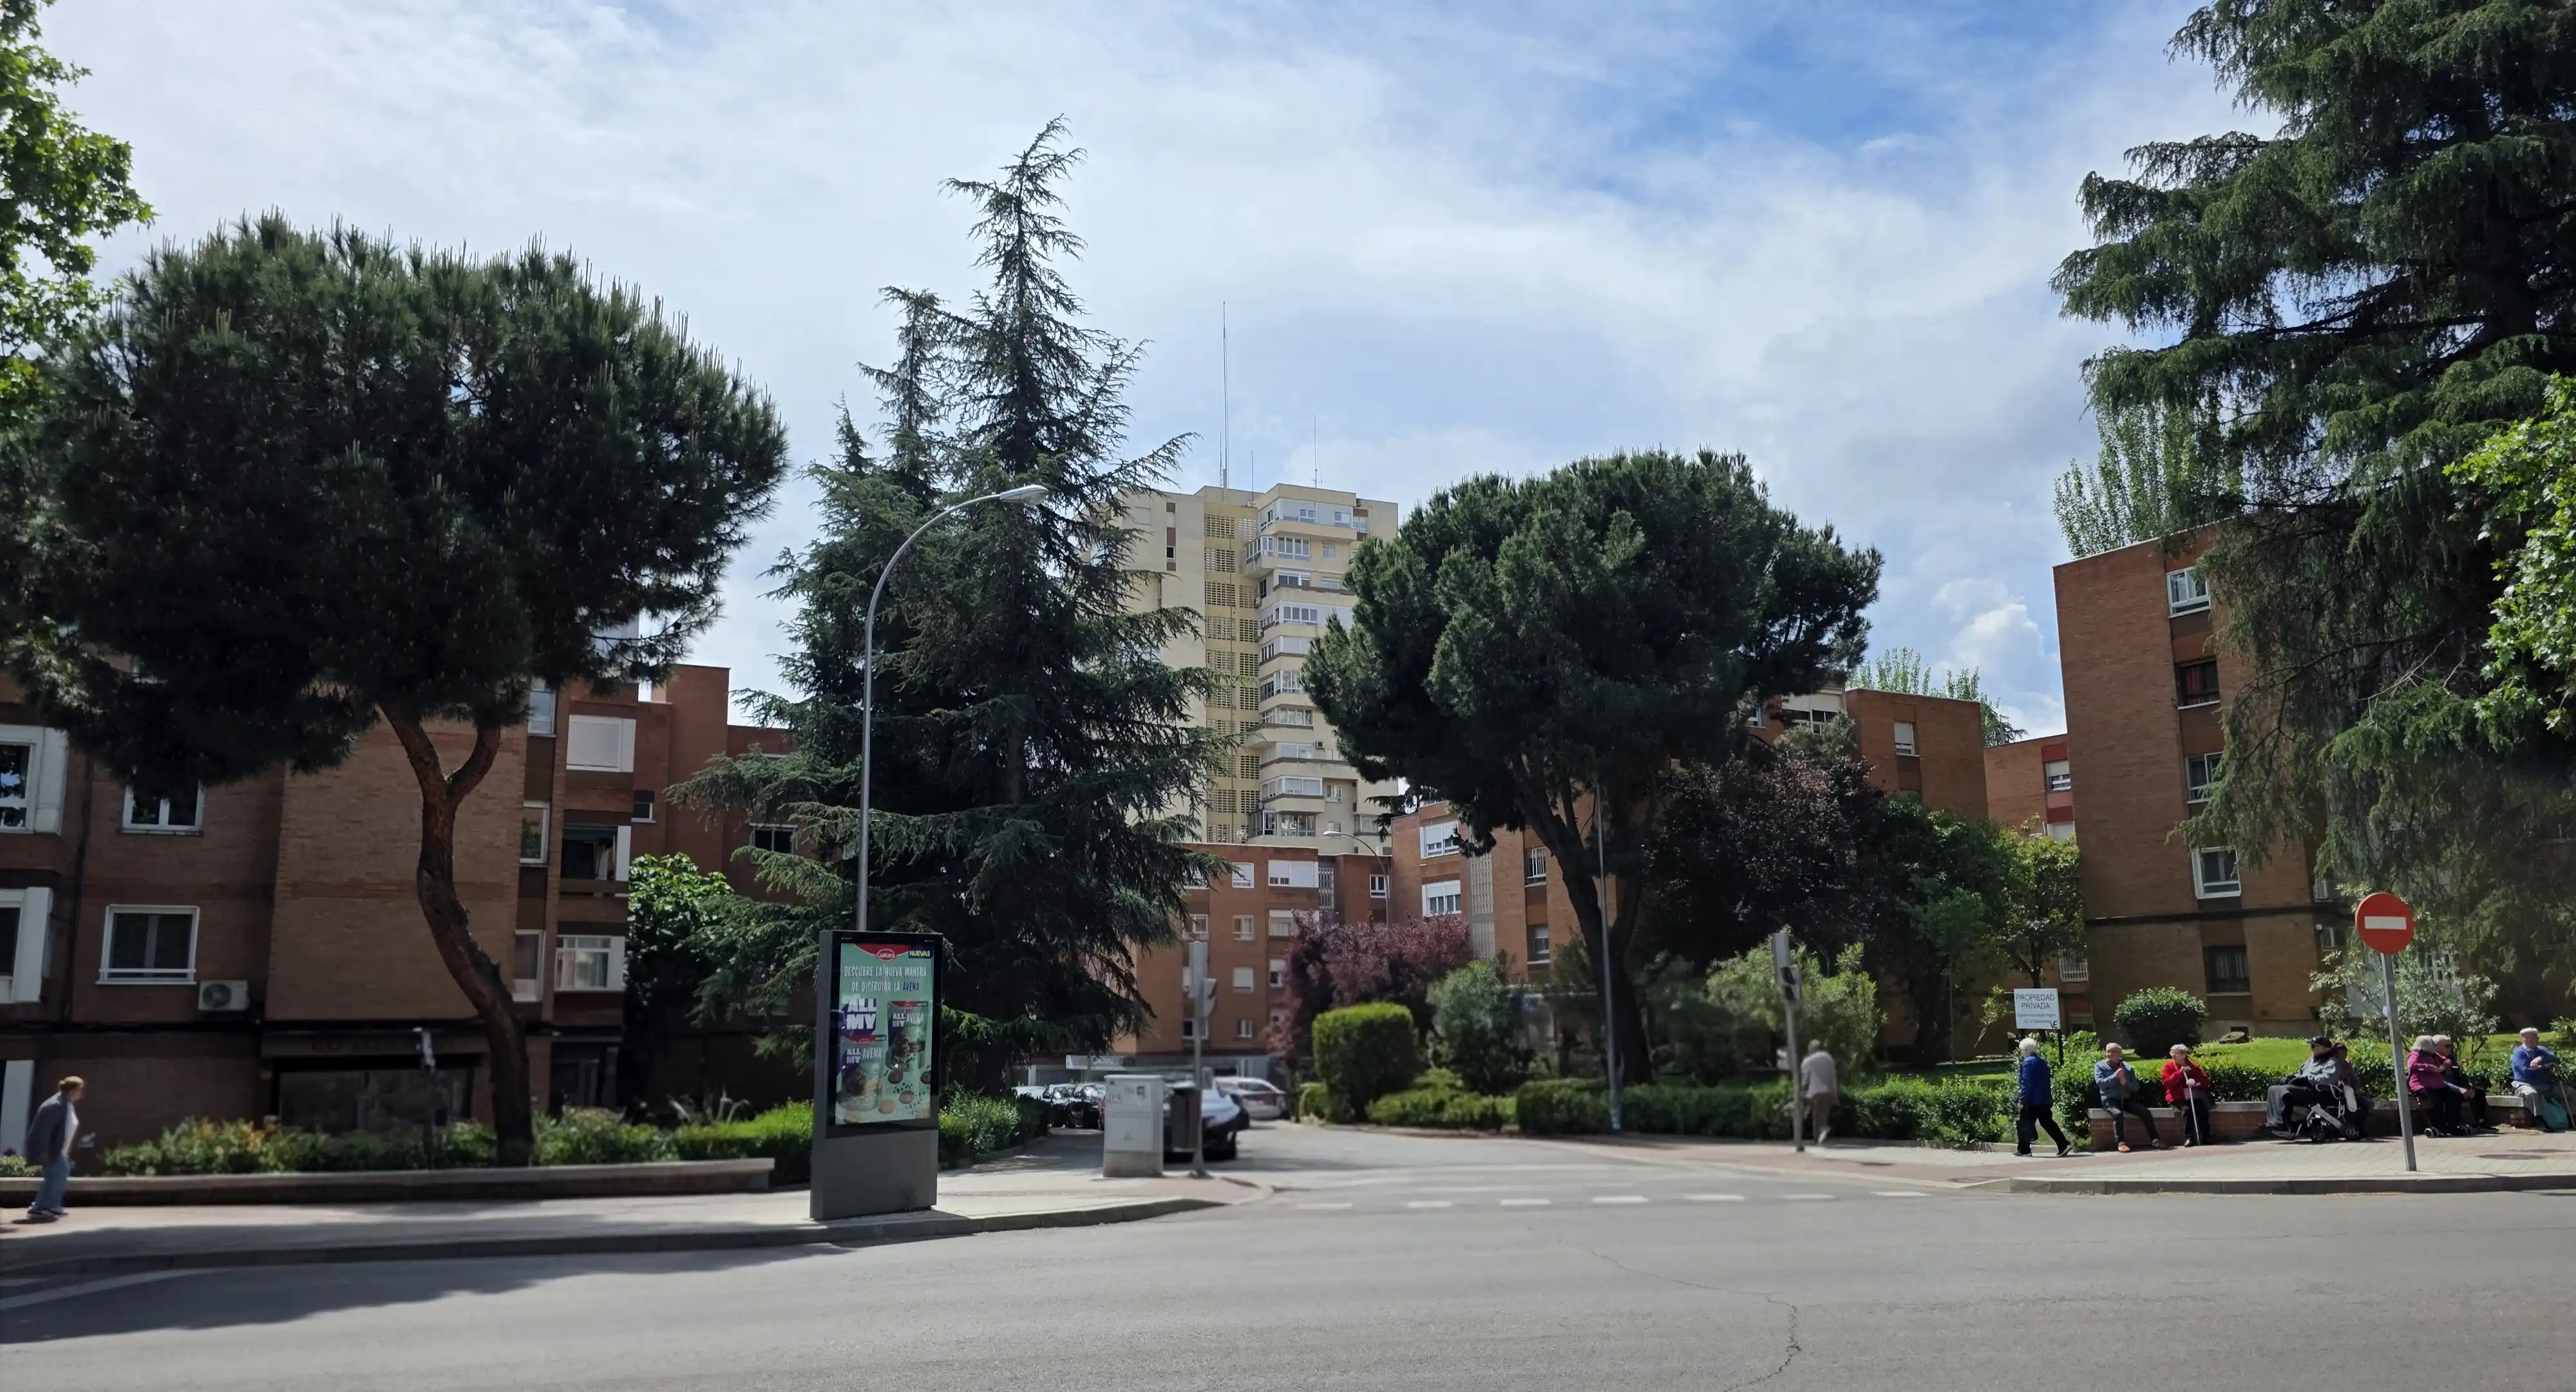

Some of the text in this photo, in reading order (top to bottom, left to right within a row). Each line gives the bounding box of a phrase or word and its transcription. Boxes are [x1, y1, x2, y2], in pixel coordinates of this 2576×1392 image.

[844, 966, 927, 977] DESCUBRE LA NUEVA MANERA
[851, 981, 920, 992] DE DISFRUTAR LA AVENA
[847, 998, 876, 1012] ALL
[846, 1013, 876, 1030] MY
[906, 1012, 924, 1025] AVENA
[862, 1047, 882, 1059] AVENA
